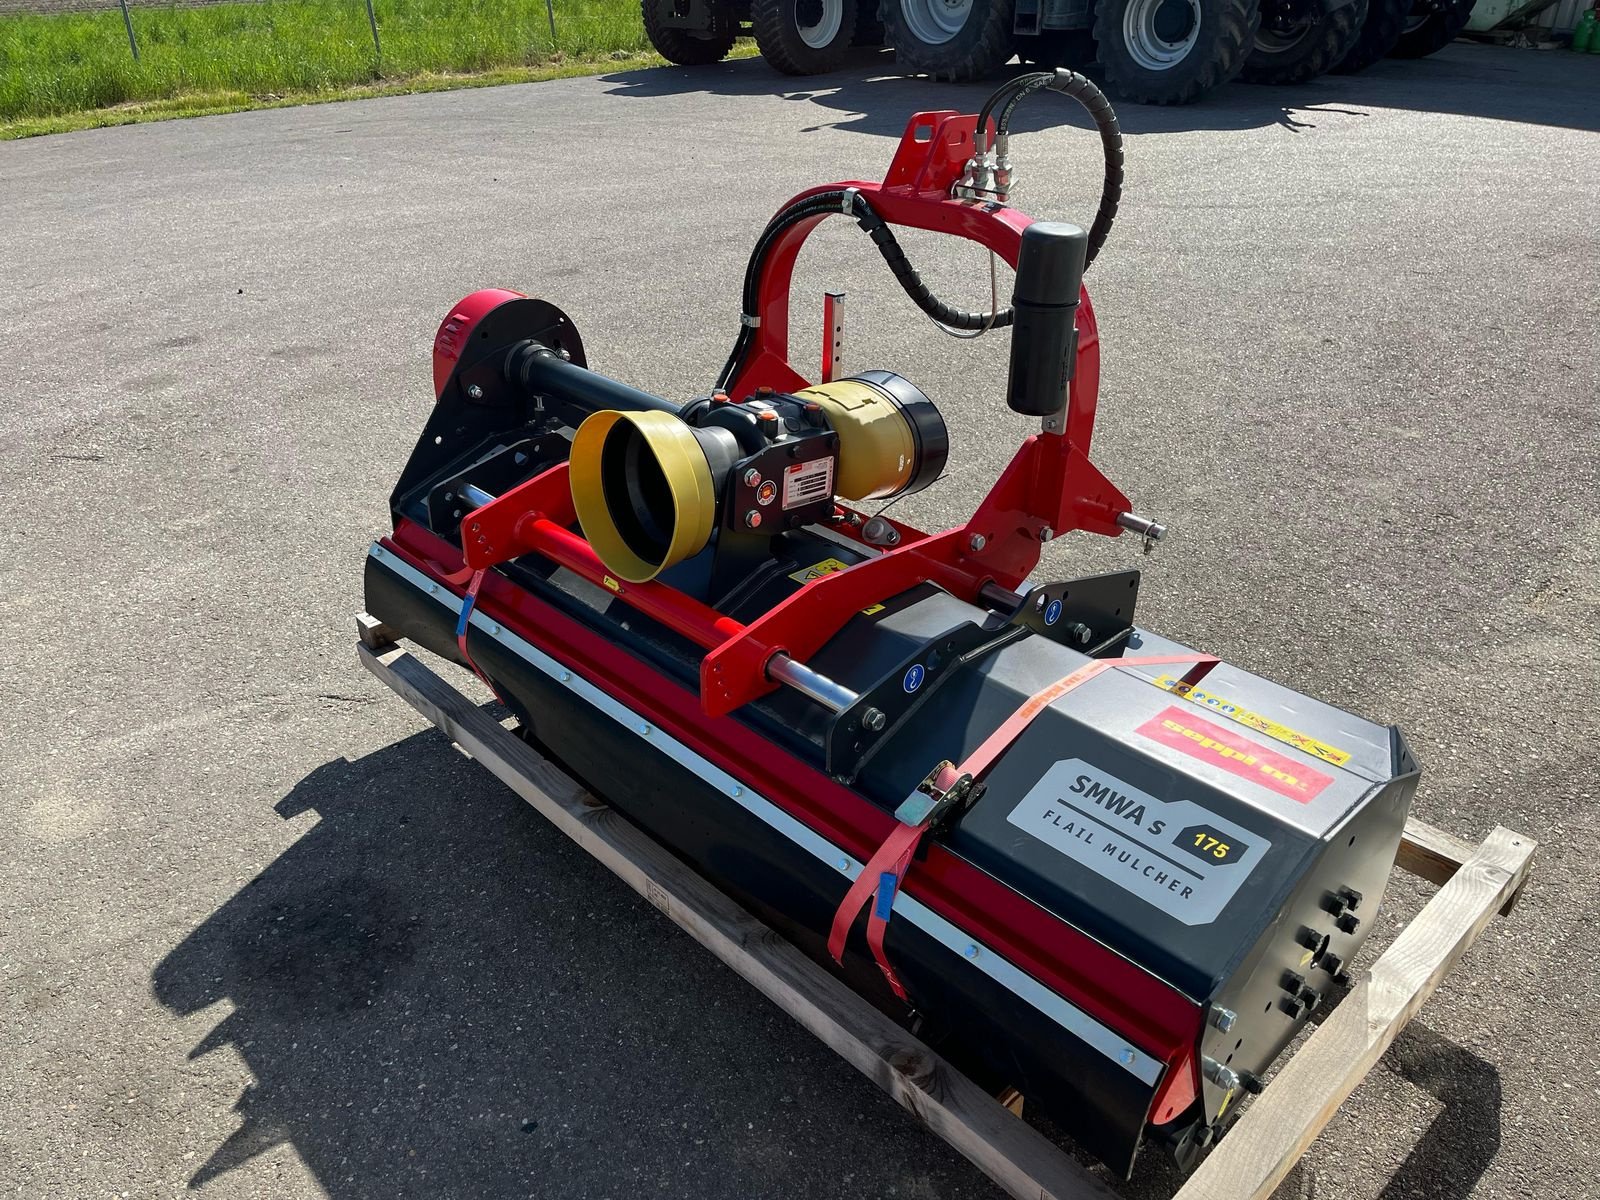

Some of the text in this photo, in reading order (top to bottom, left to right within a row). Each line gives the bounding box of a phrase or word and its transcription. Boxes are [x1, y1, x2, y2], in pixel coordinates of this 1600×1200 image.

[1161, 719, 1258, 766] seppi
[1069, 775, 1147, 826] SMWA
[1042, 809, 1194, 900] FLAIL MULCHER
[1194, 832, 1231, 859] 175
